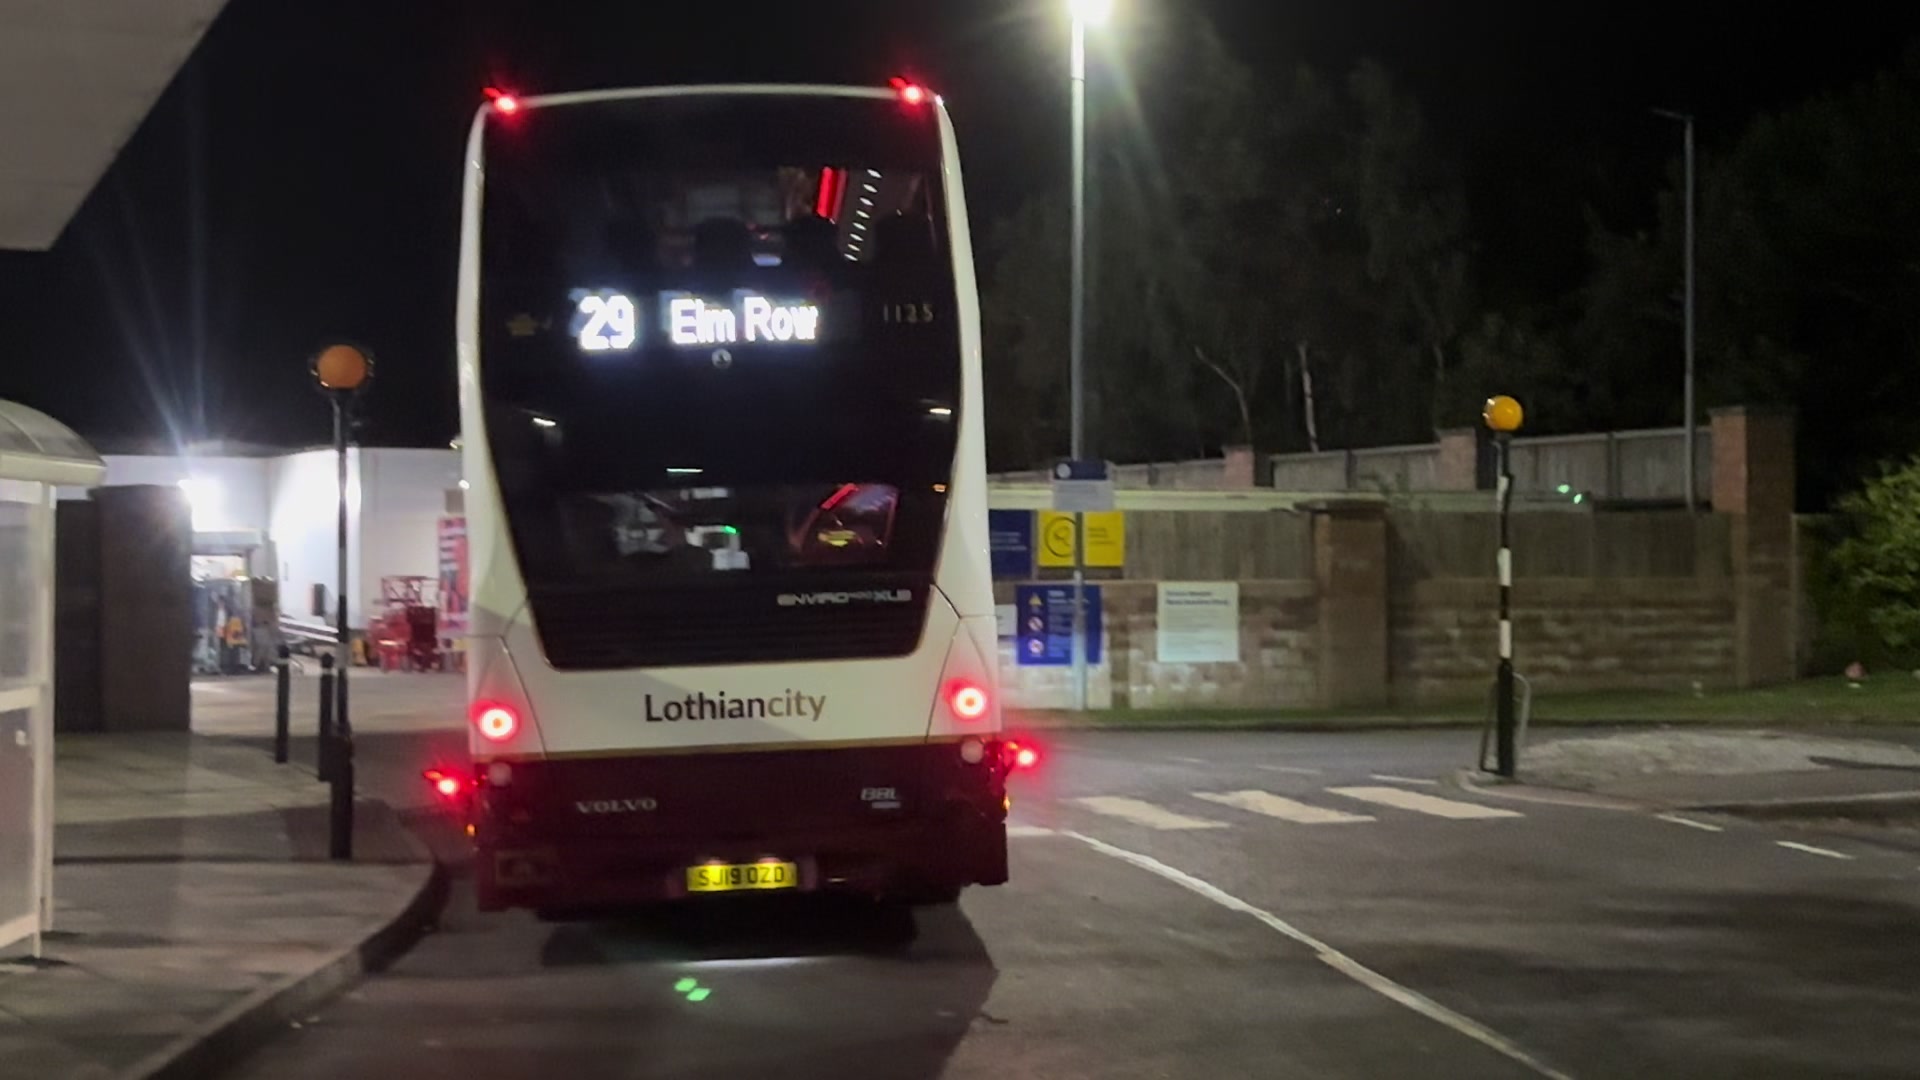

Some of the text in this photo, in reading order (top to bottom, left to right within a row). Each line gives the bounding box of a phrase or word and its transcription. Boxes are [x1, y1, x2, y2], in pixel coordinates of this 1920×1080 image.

[578, 295, 819, 349] 29 Elm Row
[575, 798, 657, 814] VOLVO
[698, 867, 742, 886] SJ19
